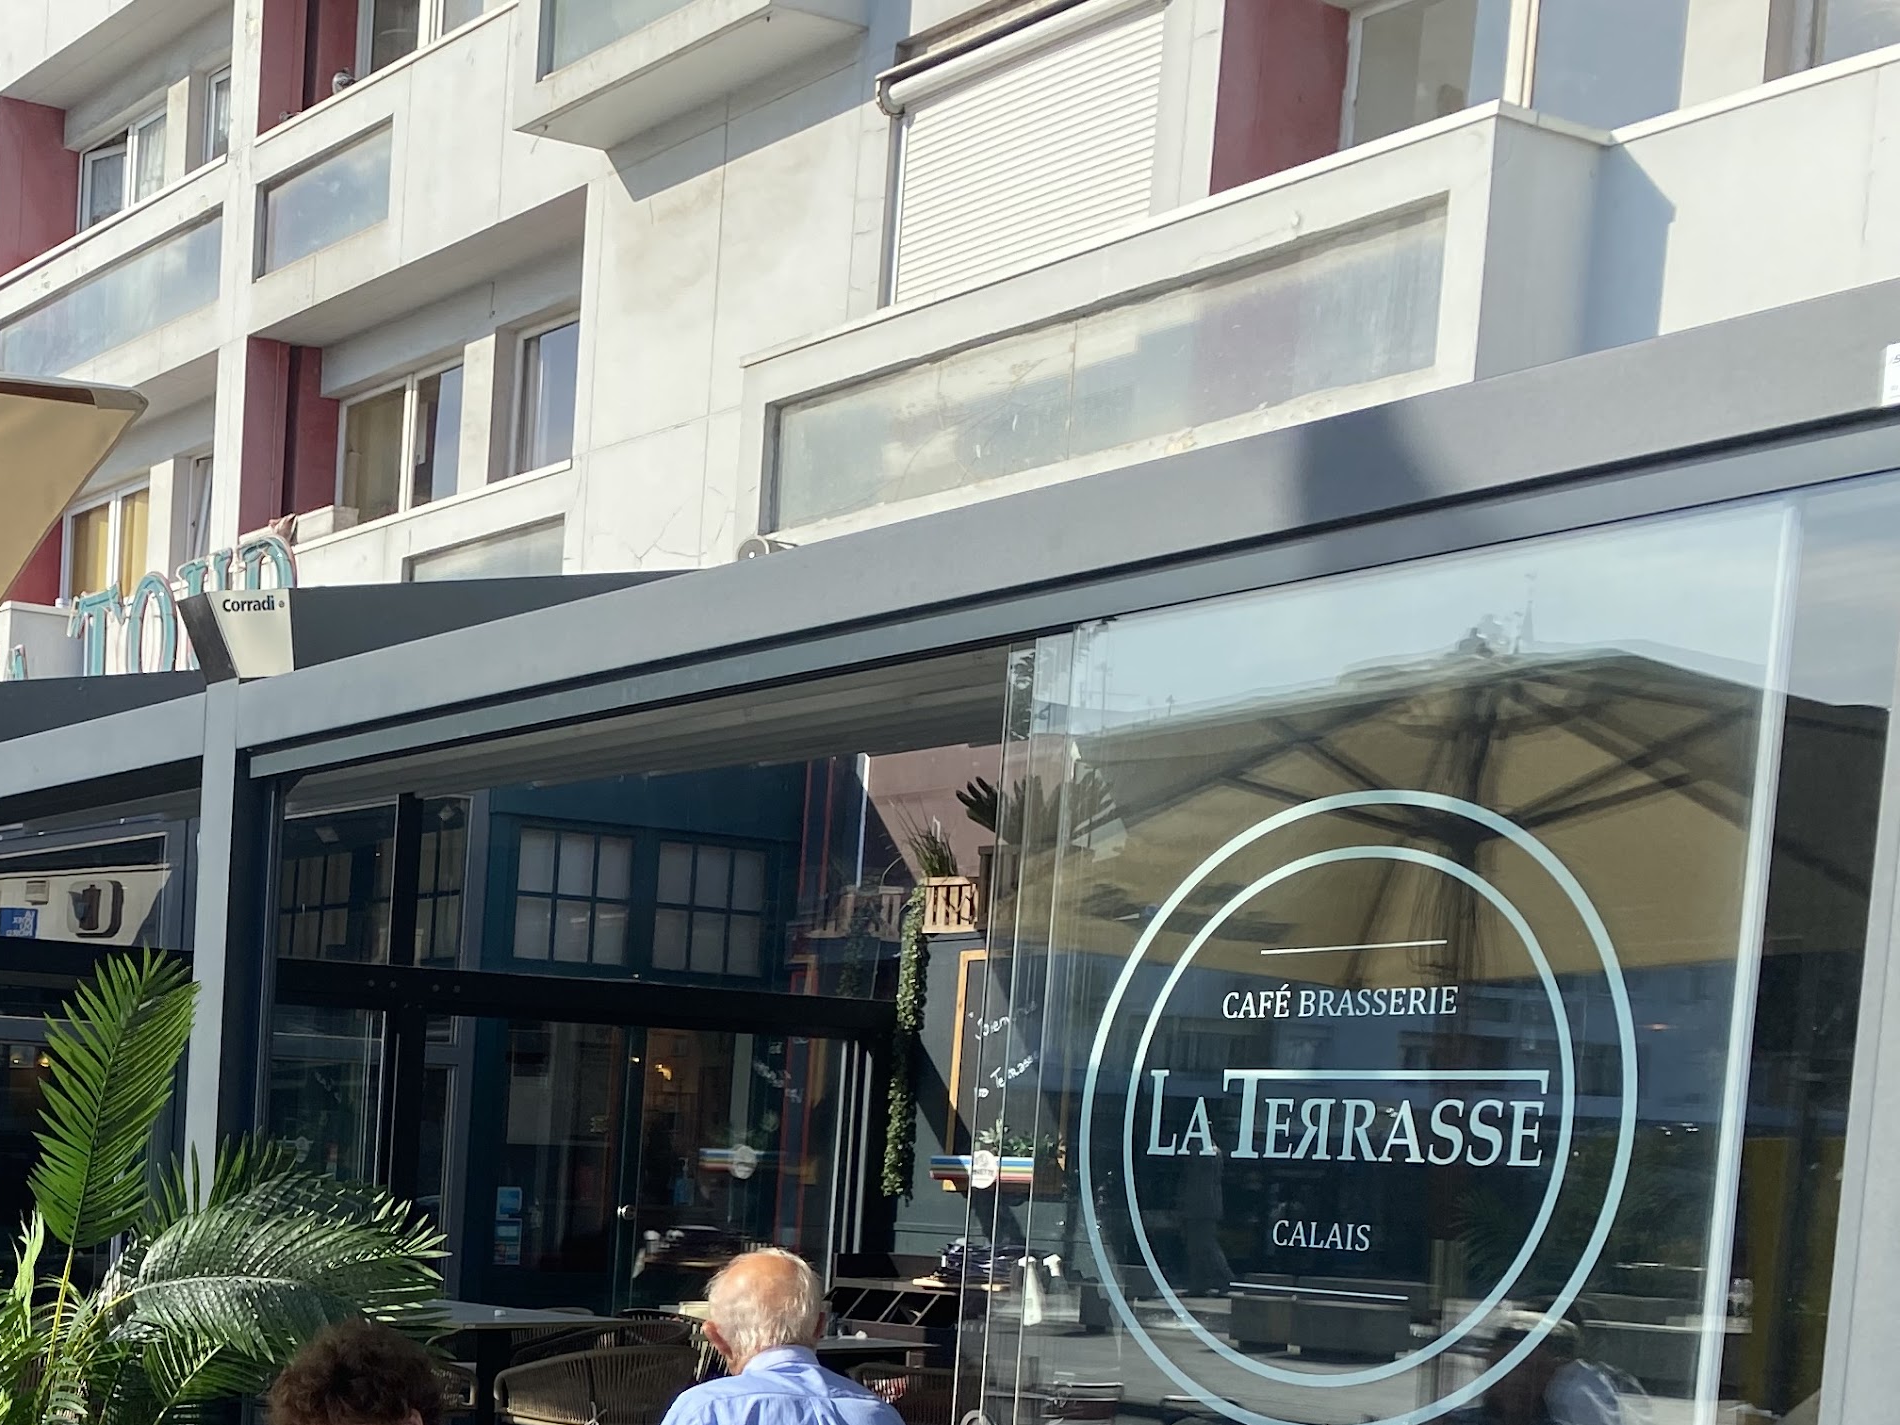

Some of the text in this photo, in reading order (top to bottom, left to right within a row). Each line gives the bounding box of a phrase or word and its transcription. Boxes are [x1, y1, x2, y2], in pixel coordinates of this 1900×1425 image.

[222, 594, 275, 613] Corradi
[1222, 983, 1460, 1019] CAFÉ BRASSERIE
[1146, 1069, 1217, 1157] LA
[1272, 1219, 1372, 1252] CALAIS
